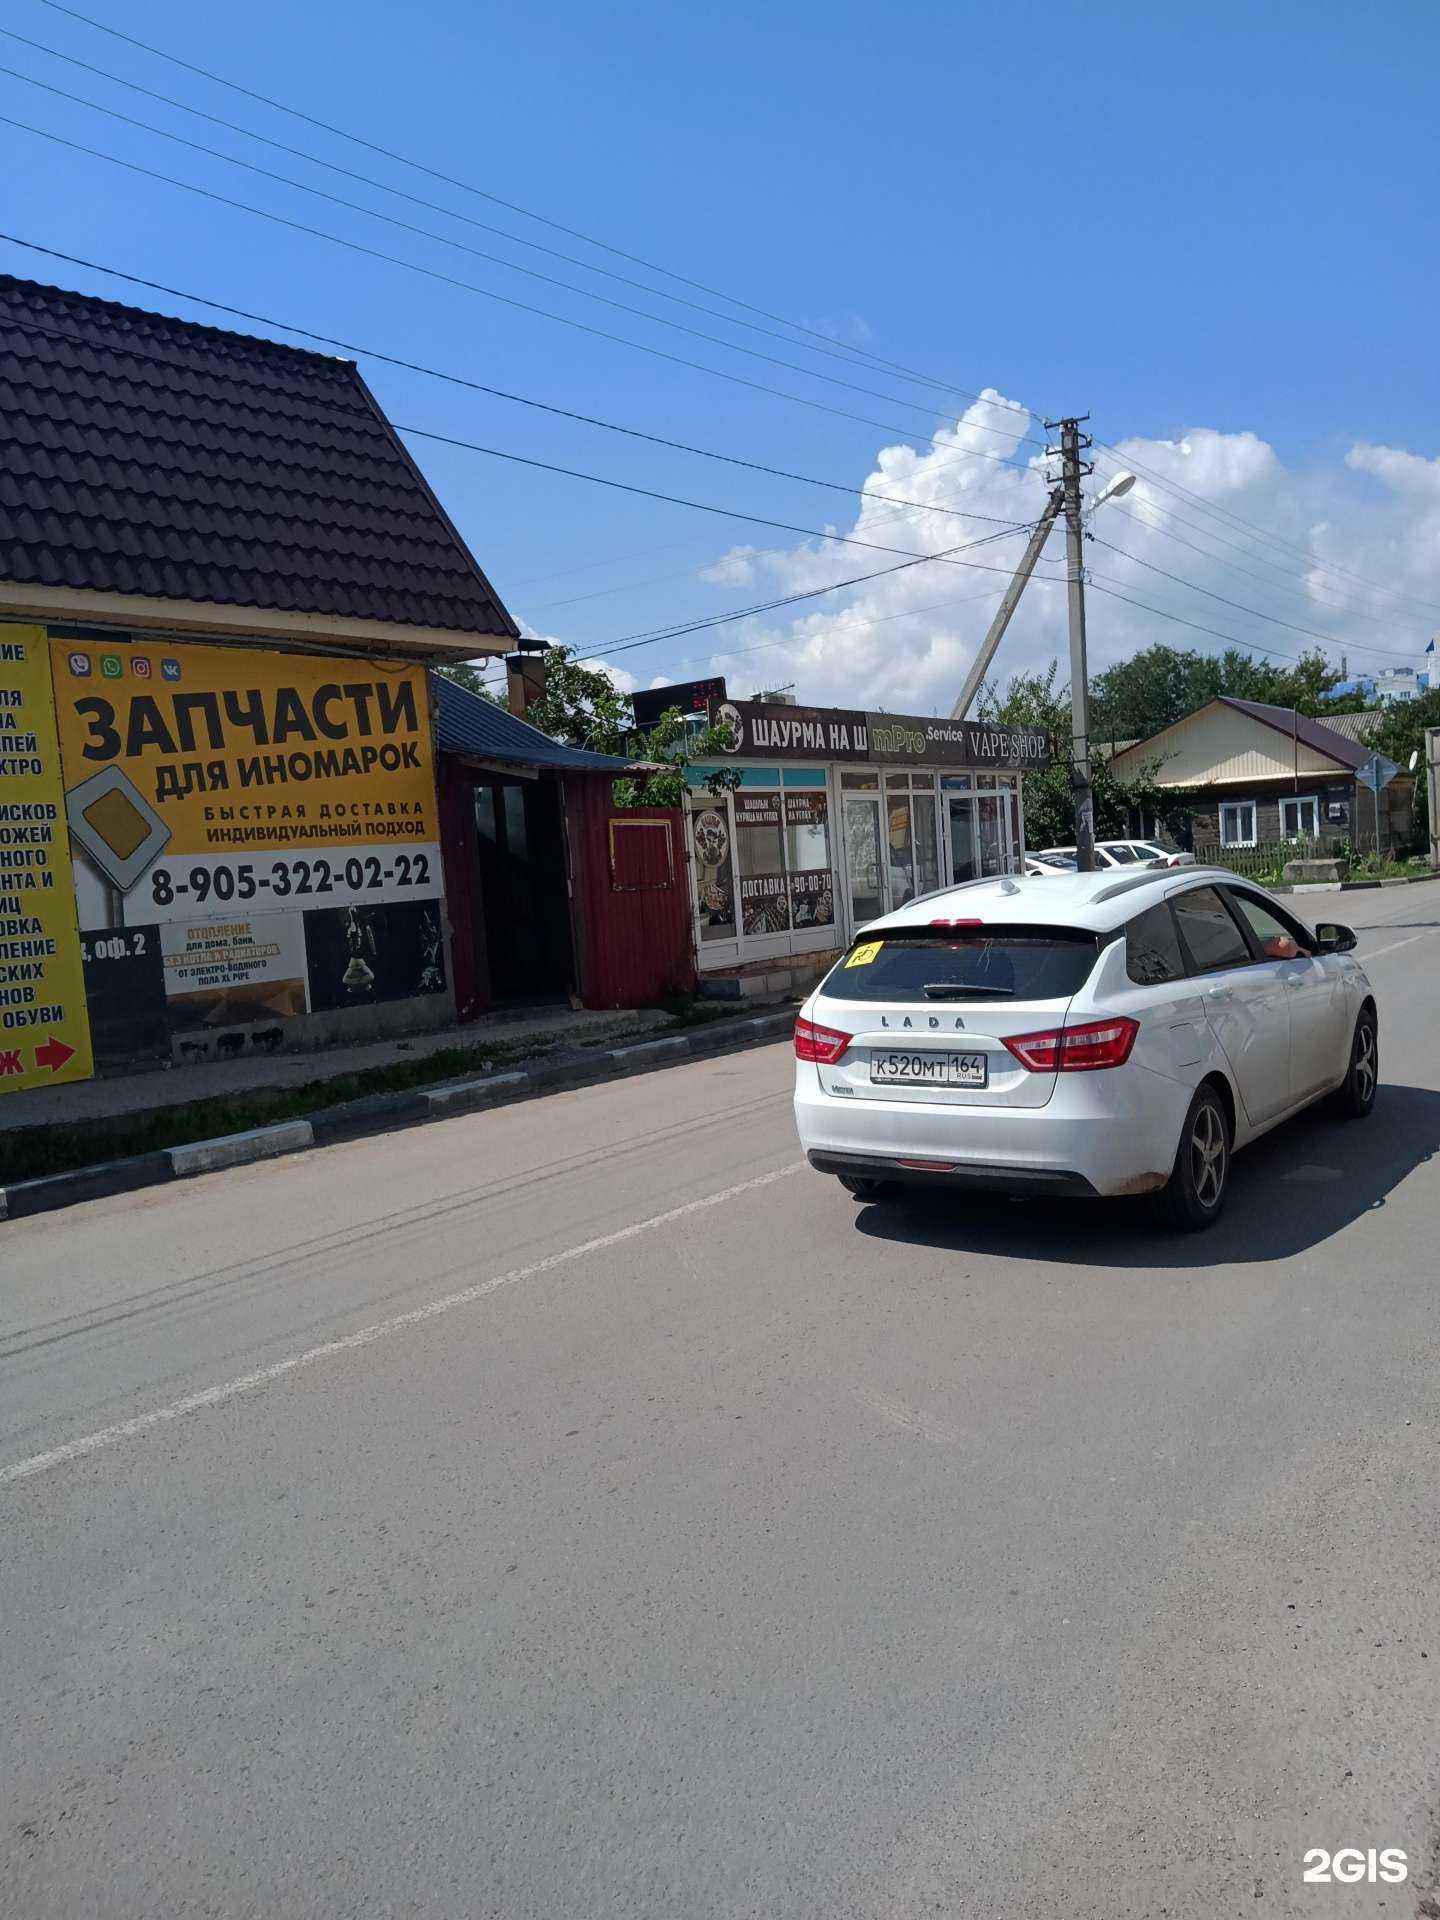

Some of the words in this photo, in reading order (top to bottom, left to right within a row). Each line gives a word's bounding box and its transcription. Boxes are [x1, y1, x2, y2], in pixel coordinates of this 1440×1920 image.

[75, 681, 418, 761] ЗАПЧАСТИ
[752, 718, 826, 748] ШАУРМА
[829, 724, 850, 750] НА
[873, 724, 926, 754] mPro
[970, 731, 1009, 757] VAPE
[1010, 733, 1045, 758] SHOP
[155, 760, 229, 802] ДЛЯ
[237, 741, 421, 787] ИНОМАРОК
[204, 804, 307, 821] БЫСТРАЯ
[320, 802, 424, 817] ДОСТАВКА
[0, 823, 52, 844] ОЖЕЙ
[207, 820, 362, 844] ИНДИВИДУАЛЬНЫЙ
[365, 821, 426, 836] ПОДХОД
[0, 874, 36, 890] НТА
[42, 872, 53, 888] И
[152, 853, 430, 906] 8-905-322-02-22
[742, 878, 786, 898] ДОСТАВКА
[795, 874, 832, 893] 90-00-70
[95, 937, 130, 960] оф.
[133, 933, 147, 955] 2
[3, 1004, 64, 1028] ОБУВИ
[881, 1015, 966, 1030] LADA
[876, 1055, 946, 1078] К520МТ
[951, 1055, 981, 1074] 164
[956, 1072, 971, 1080] RUS
